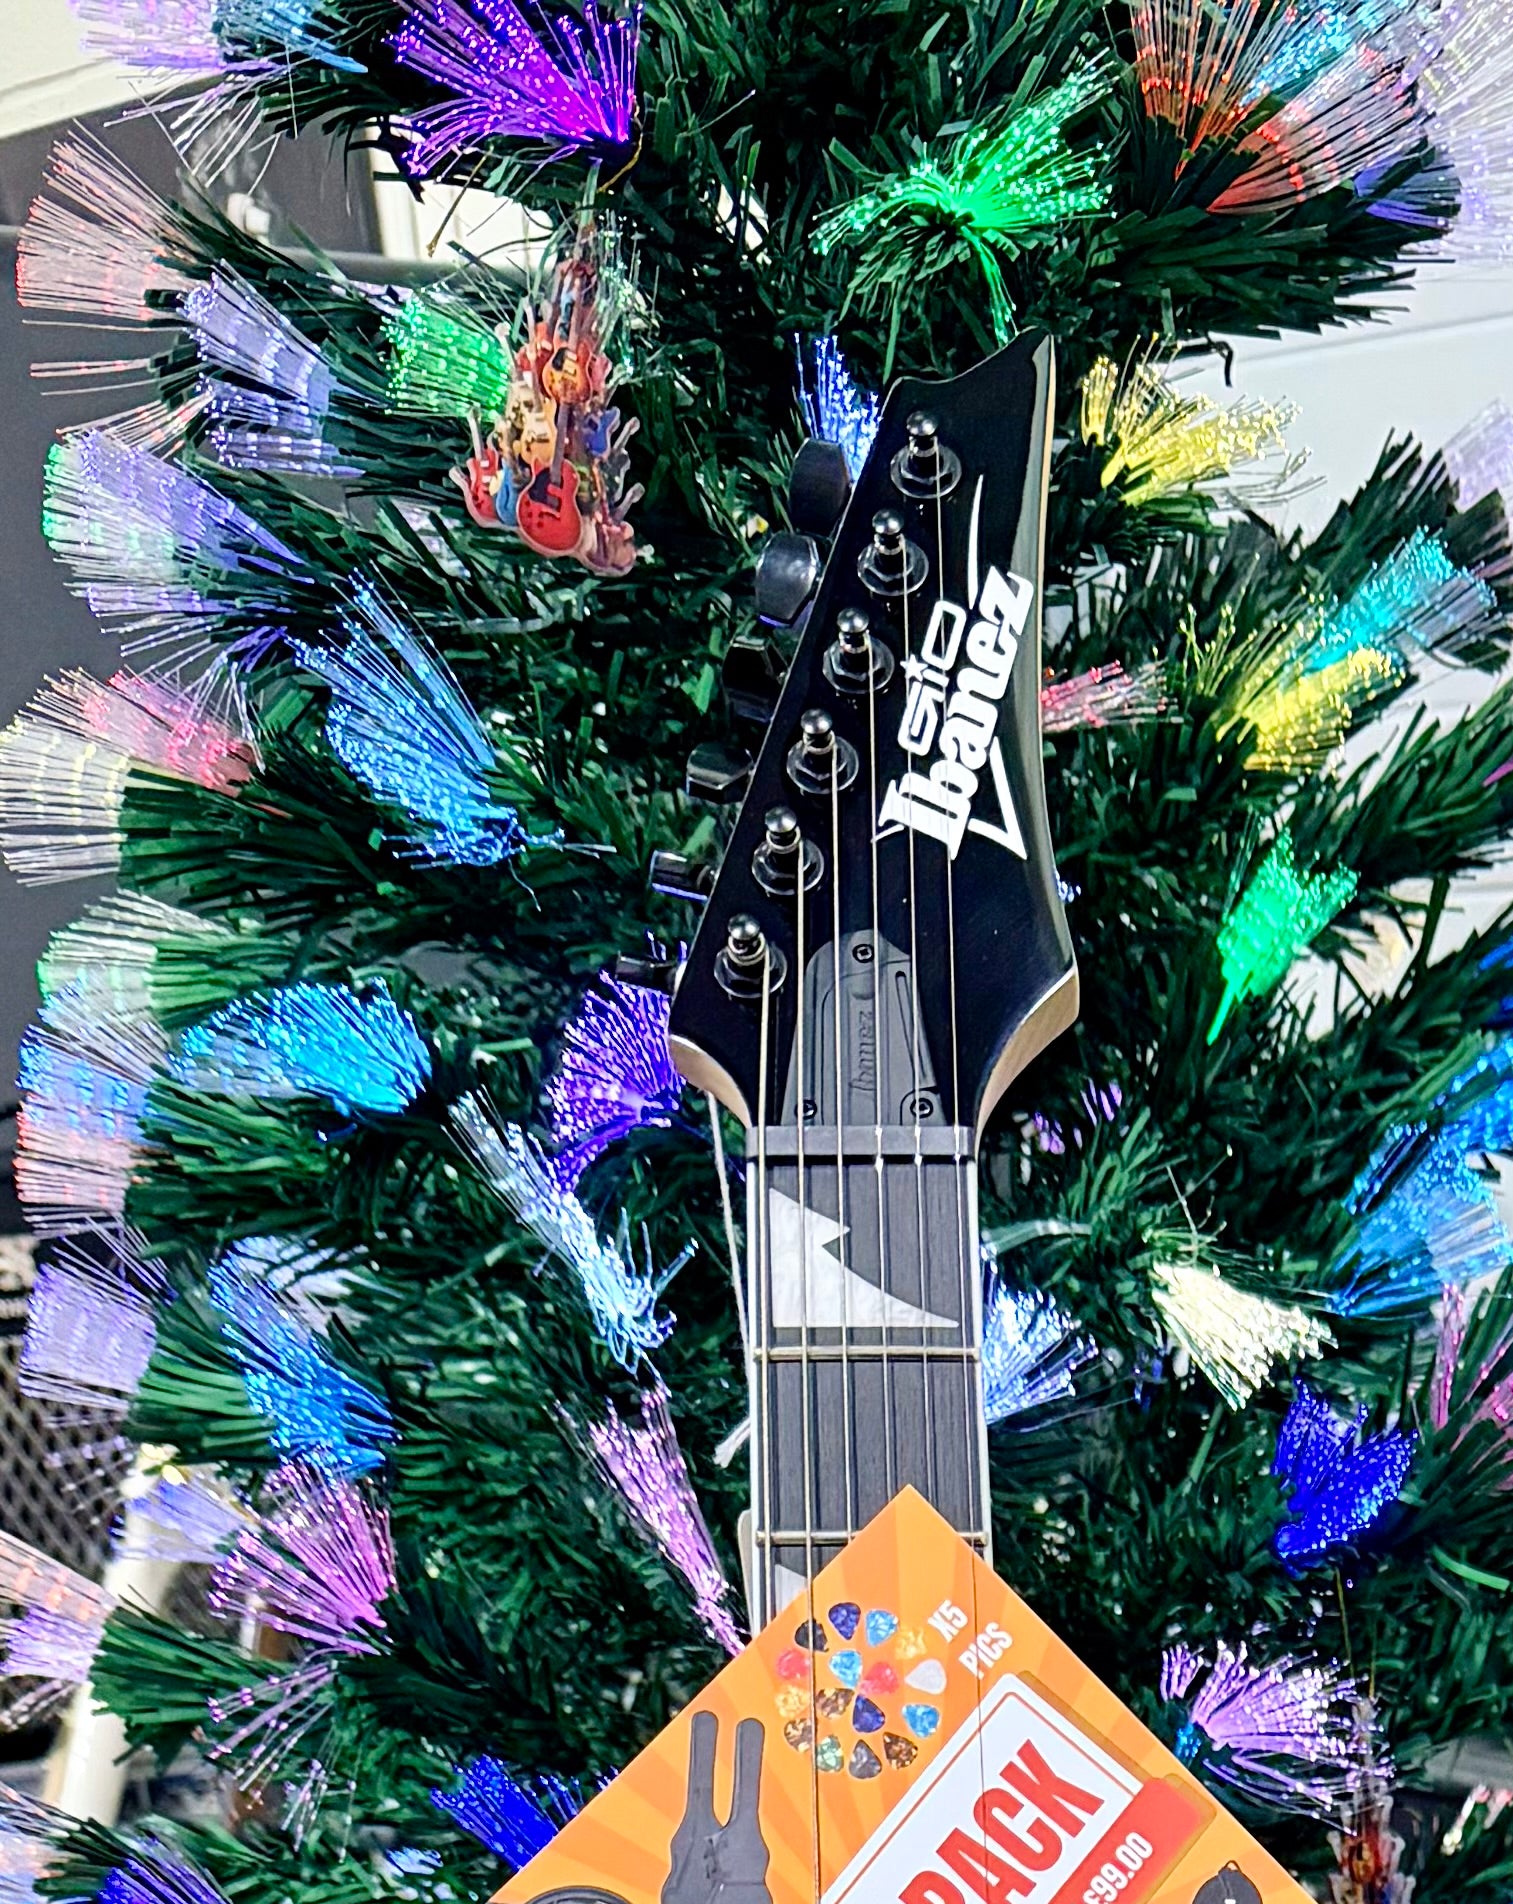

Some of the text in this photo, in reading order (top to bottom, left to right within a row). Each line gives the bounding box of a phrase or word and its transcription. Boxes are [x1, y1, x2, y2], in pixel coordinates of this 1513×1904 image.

[873, 566, 1035, 861] Ibanez
[928, 1600, 968, 1643] X5
[959, 1622, 1014, 1679] PICS
